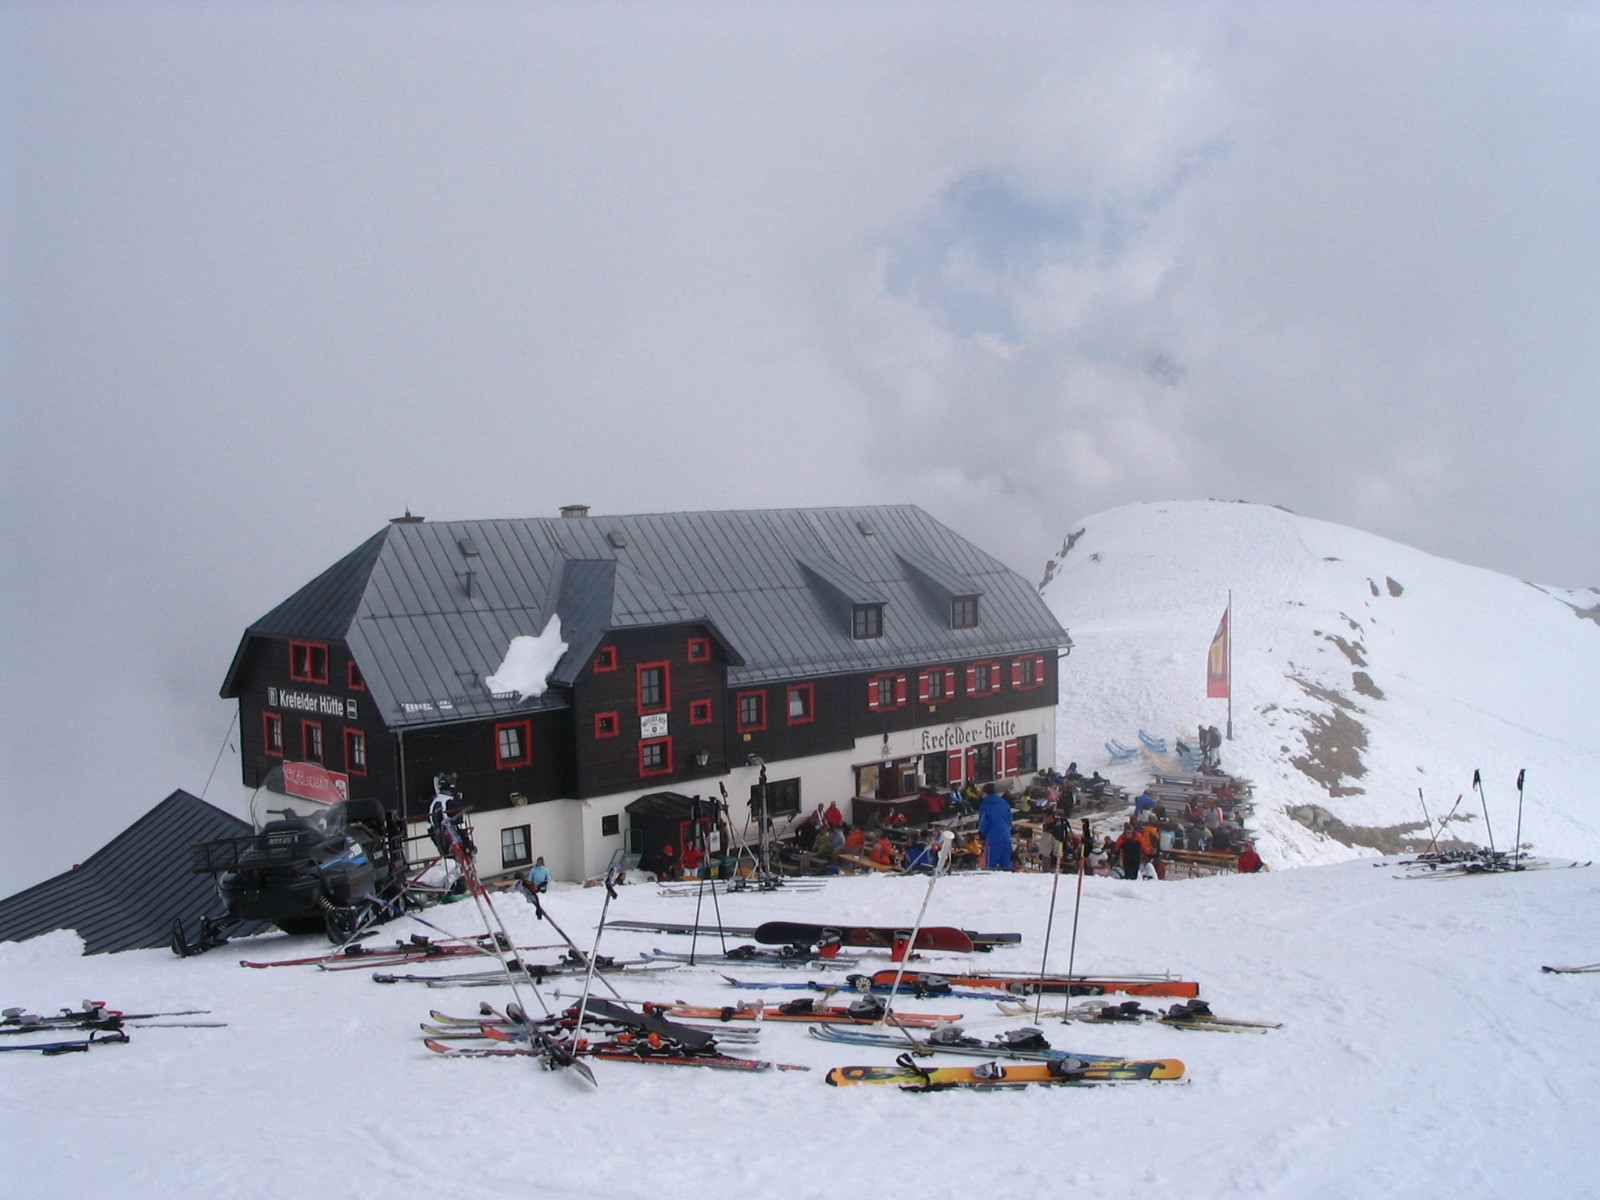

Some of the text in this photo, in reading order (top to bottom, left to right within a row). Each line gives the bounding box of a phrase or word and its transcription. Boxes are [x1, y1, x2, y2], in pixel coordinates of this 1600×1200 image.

[280, 690, 344, 716] Krefelder Hütte
[921, 720, 1015, 750] Krefelder-Hütte
